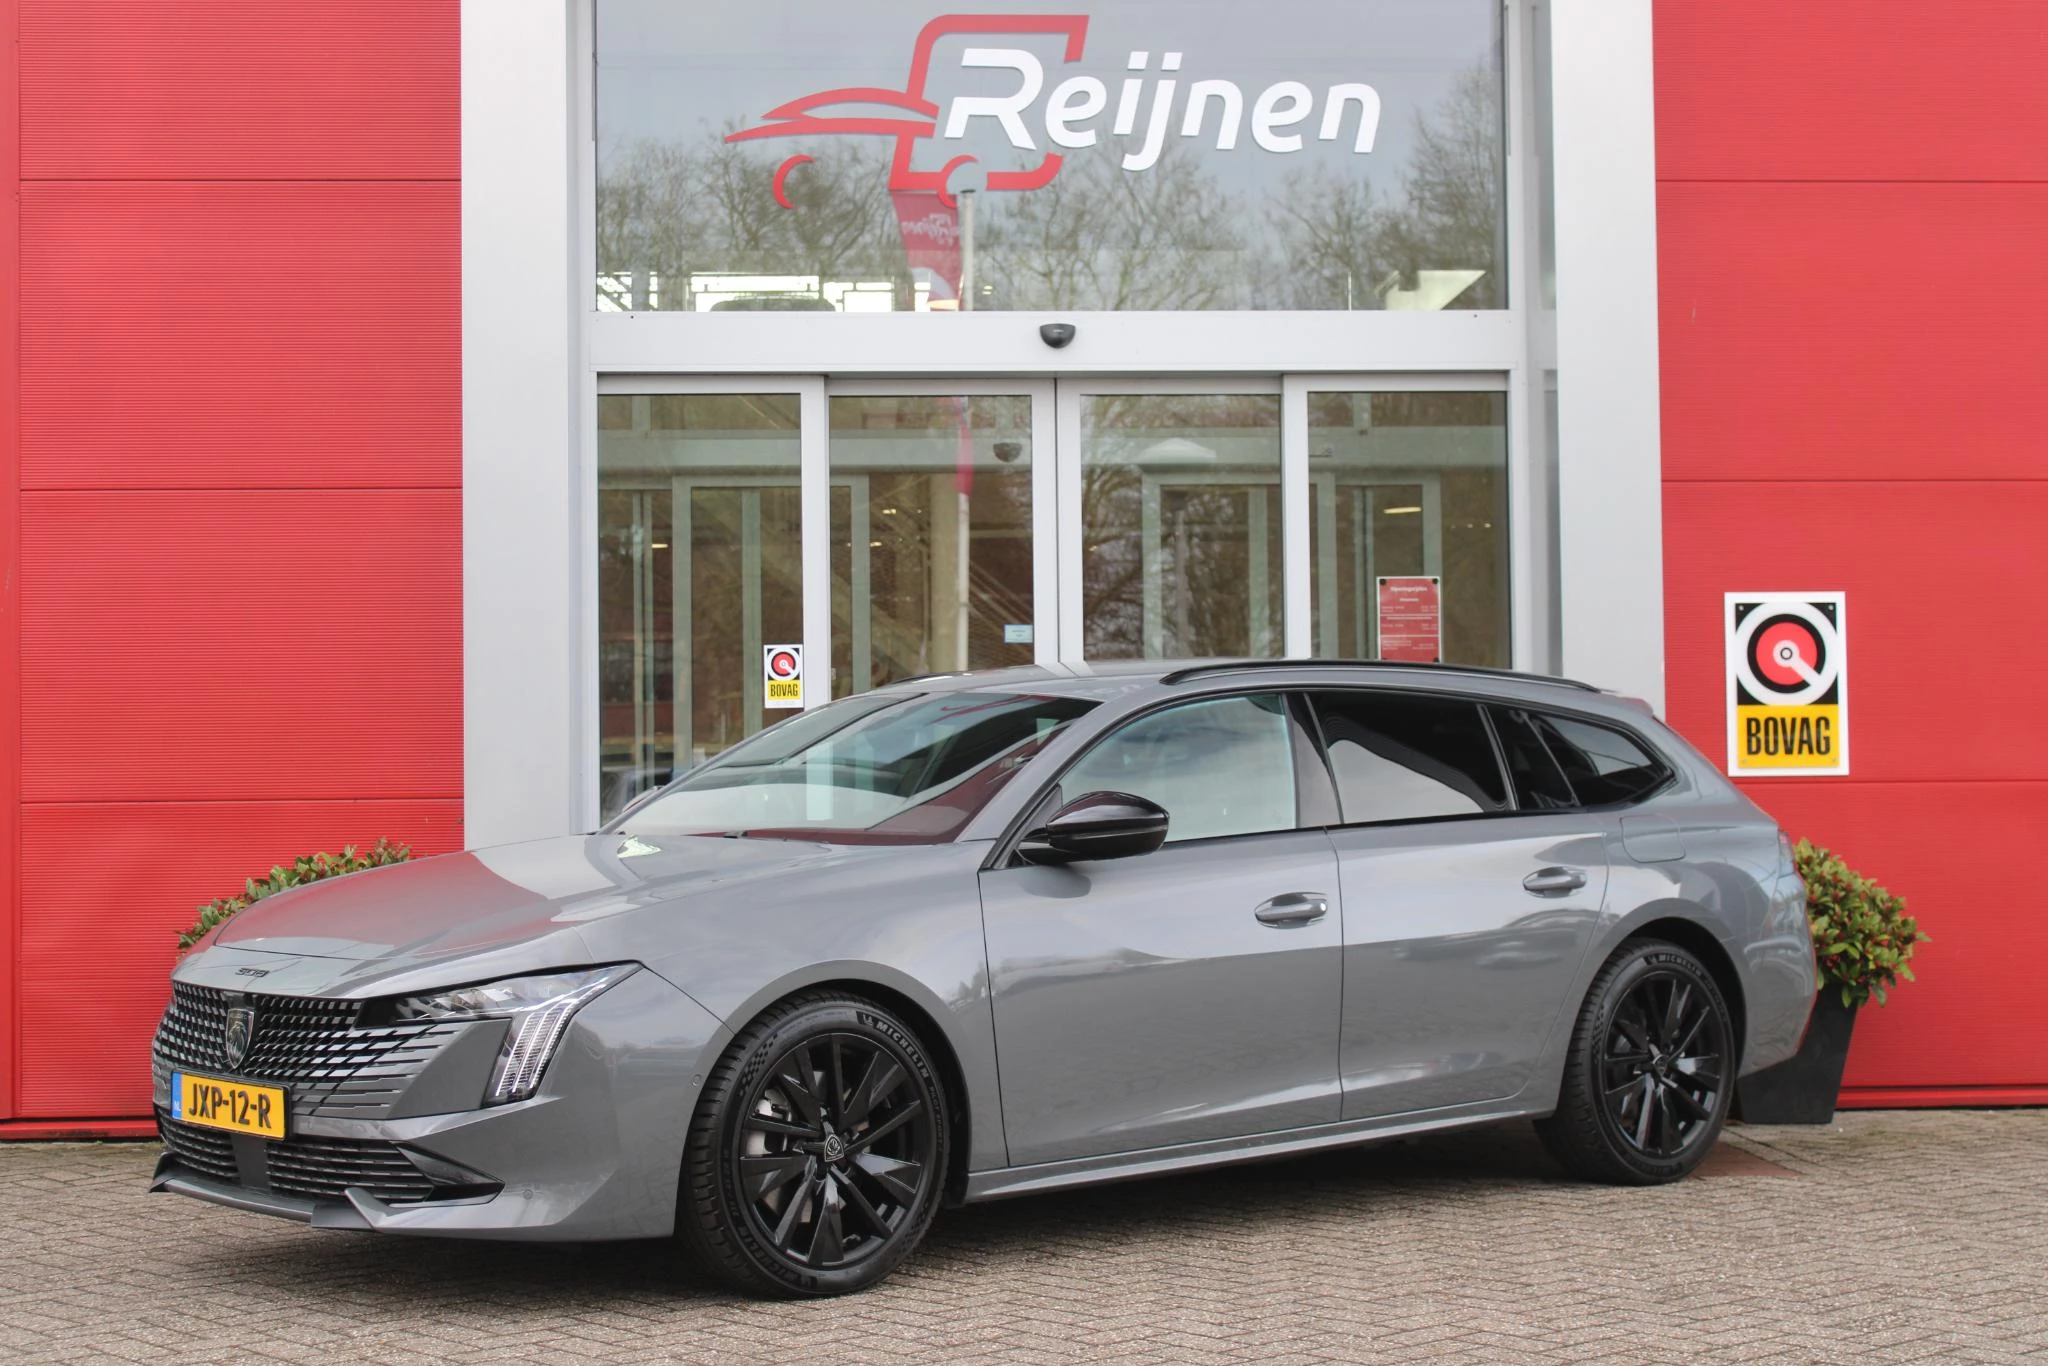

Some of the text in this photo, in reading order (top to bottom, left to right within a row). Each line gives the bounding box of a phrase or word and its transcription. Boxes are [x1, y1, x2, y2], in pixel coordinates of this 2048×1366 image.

[944, 48, 1381, 171] Reijnen
[770, 684, 798, 697] BOVAG
[1746, 716, 1831, 756] BOVAG
[876, 1021, 930, 1079] MICHELIN
[189, 1083, 272, 1129] JXP-12-R
